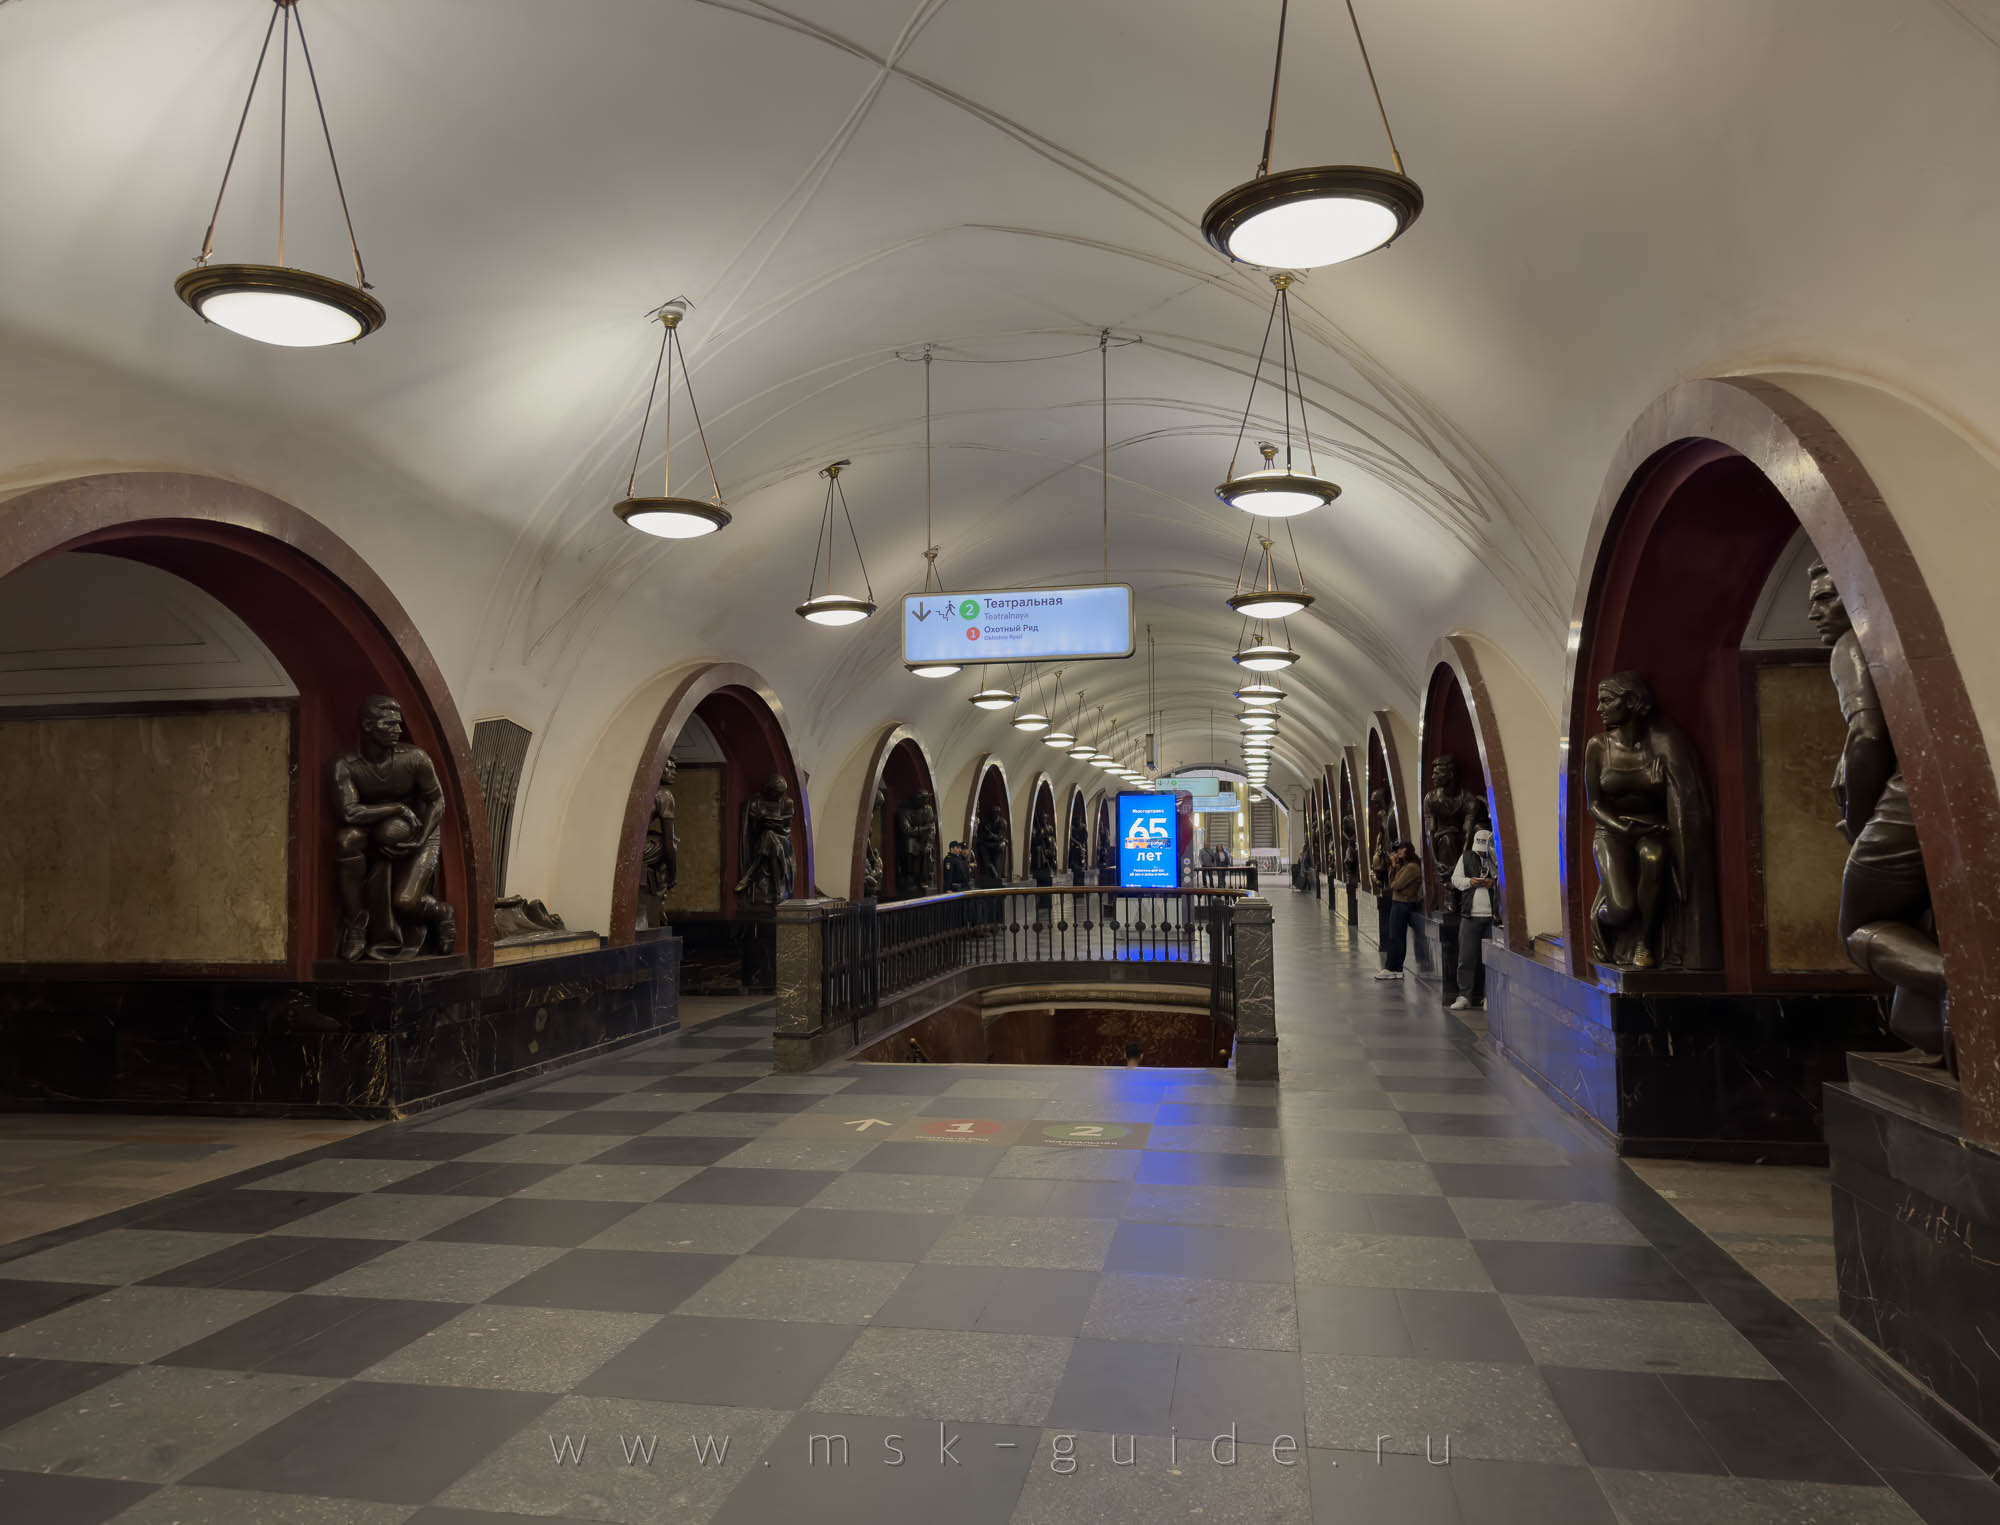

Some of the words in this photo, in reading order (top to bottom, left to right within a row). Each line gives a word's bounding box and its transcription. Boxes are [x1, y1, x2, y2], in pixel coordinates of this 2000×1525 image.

[984, 597, 1063, 609] Театральная
[965, 604, 974, 616] 2
[970, 629, 977, 638] 1
[984, 625, 1021, 633] Охотный
[1023, 624, 1039, 632] Ряд
[1129, 818, 1169, 838] 65
[1136, 851, 1163, 861] лет
[944, 1122, 976, 1133] 1
[1068, 1126, 1104, 1137] 2
